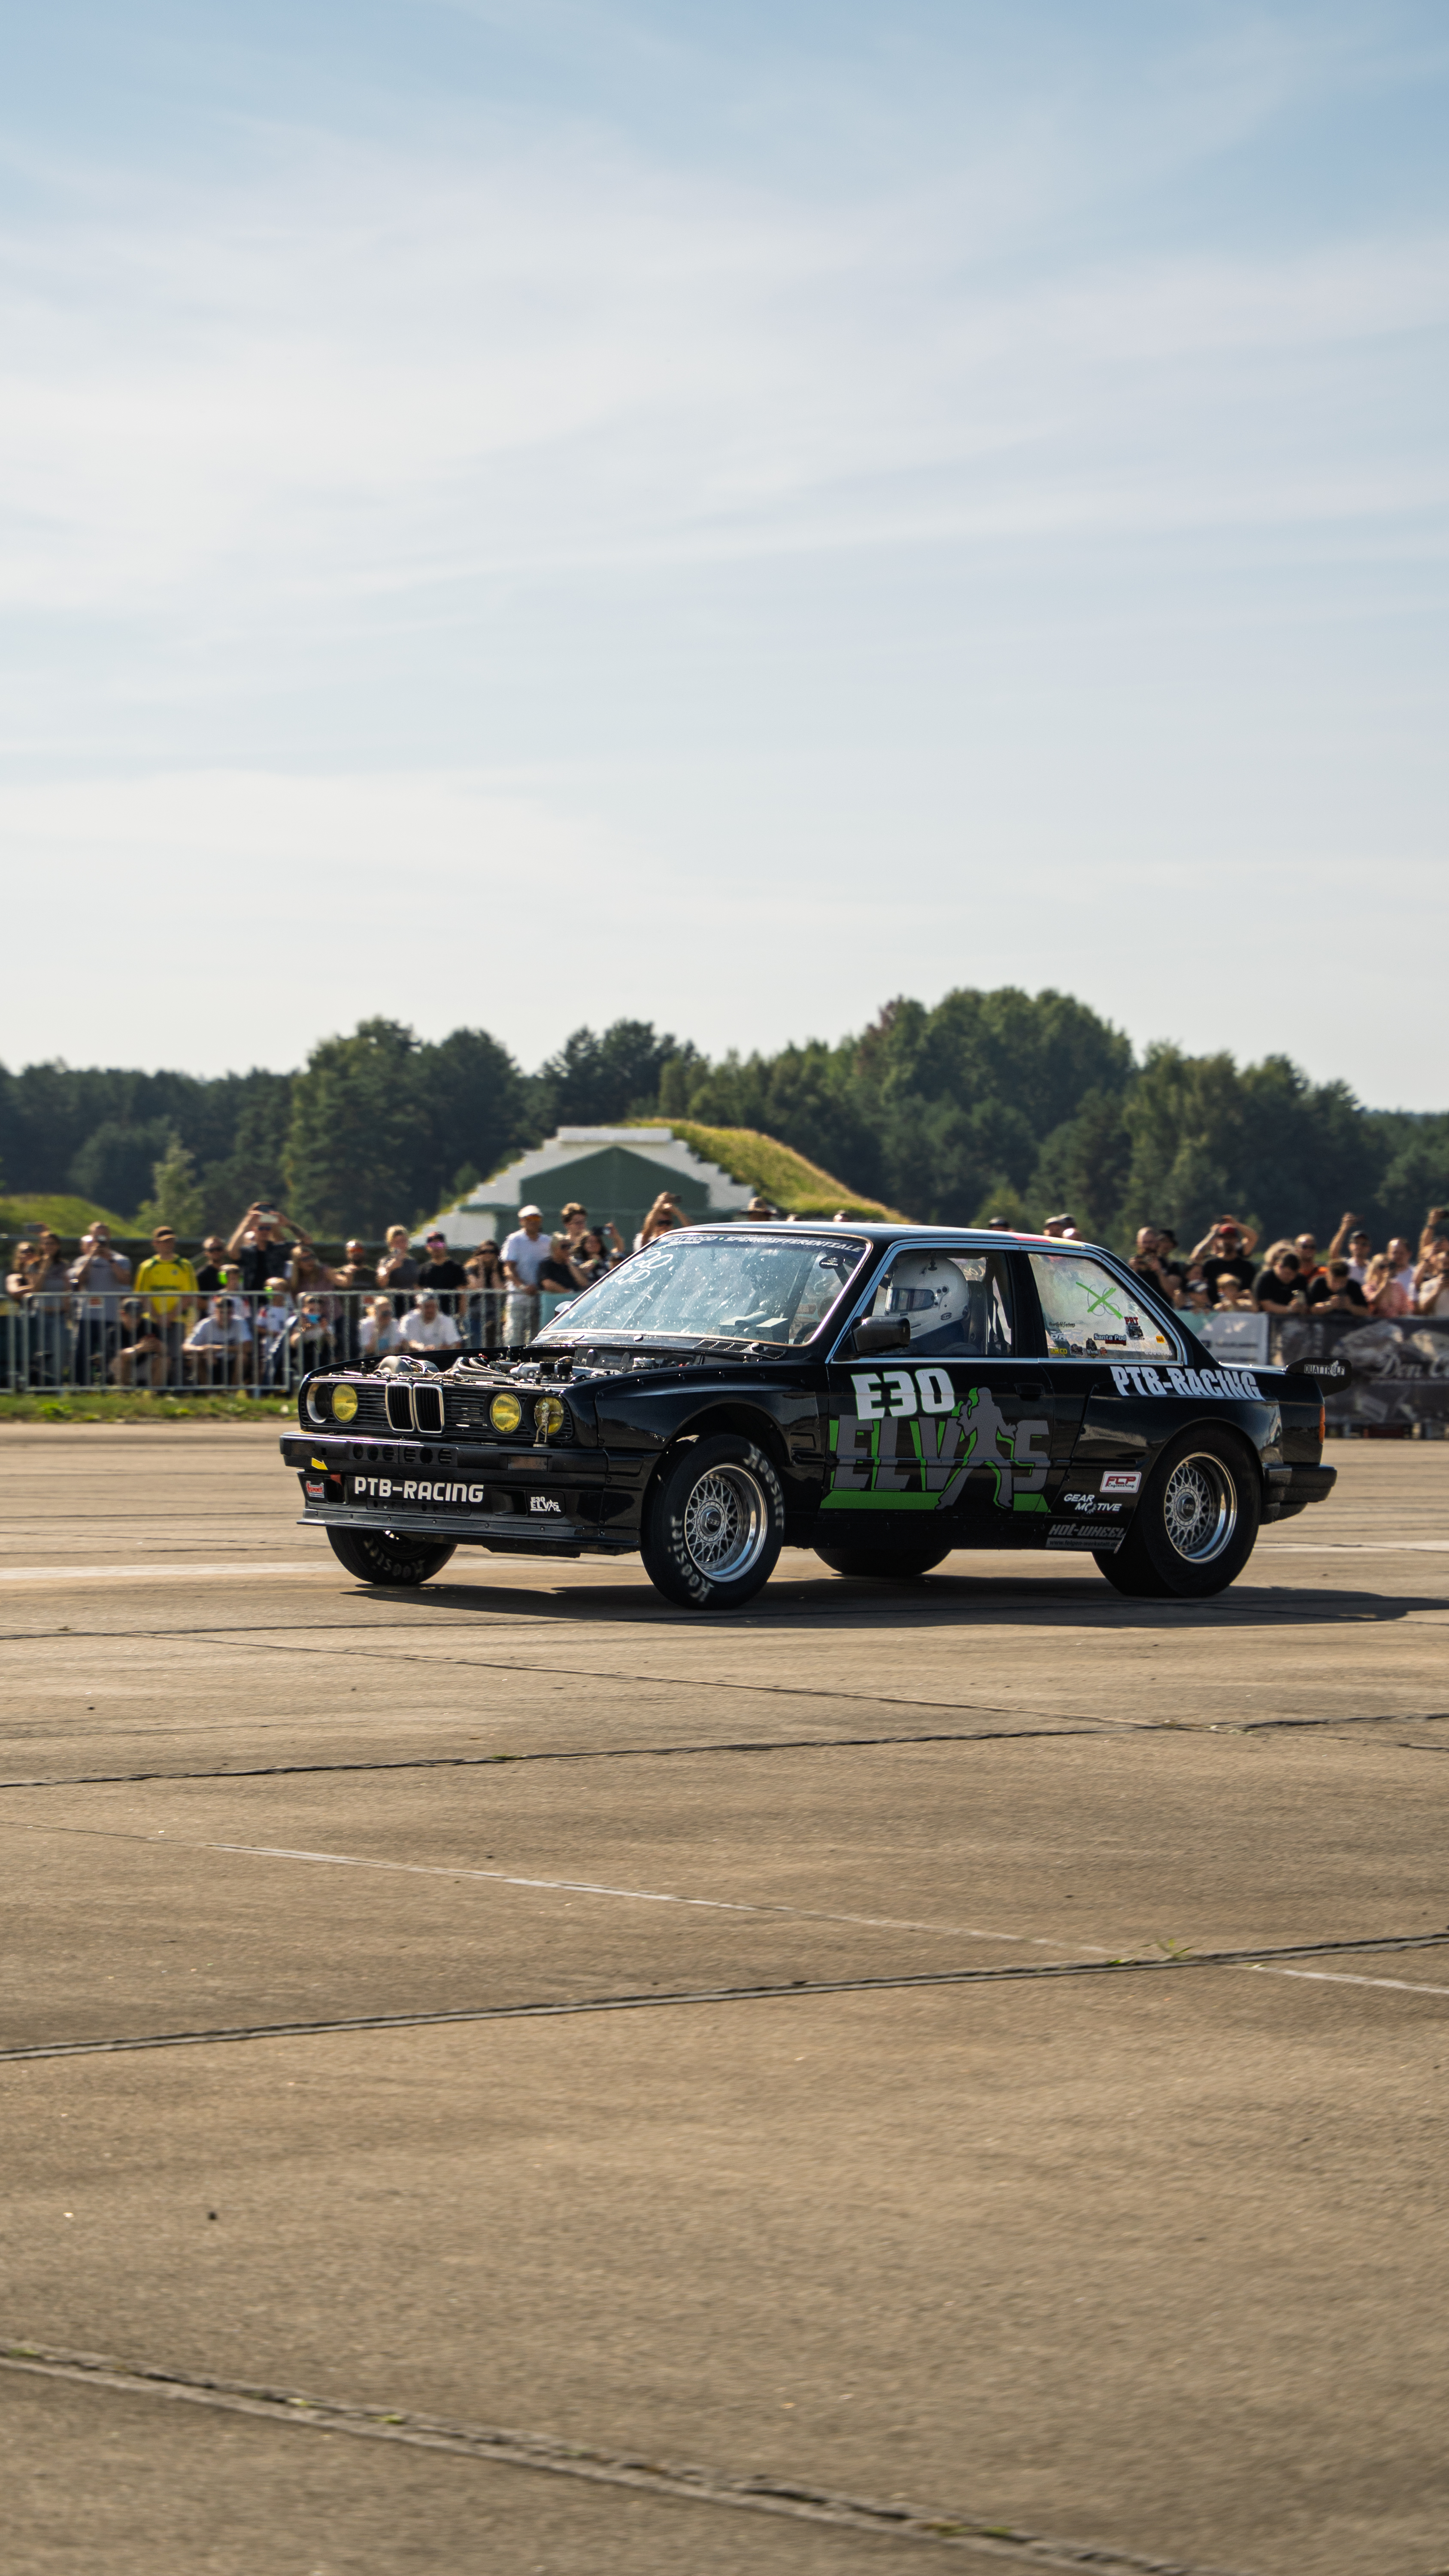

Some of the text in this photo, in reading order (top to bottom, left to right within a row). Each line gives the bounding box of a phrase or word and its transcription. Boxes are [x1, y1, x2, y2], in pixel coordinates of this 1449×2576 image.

[850, 1368, 955, 1420] E30
[1110, 1366, 1267, 1401] PTB-RACING
[355, 1476, 484, 1503] PTB-RACING
[1105, 1476, 1137, 1487] FCP
[1064, 1494, 1094, 1502] GEAR
